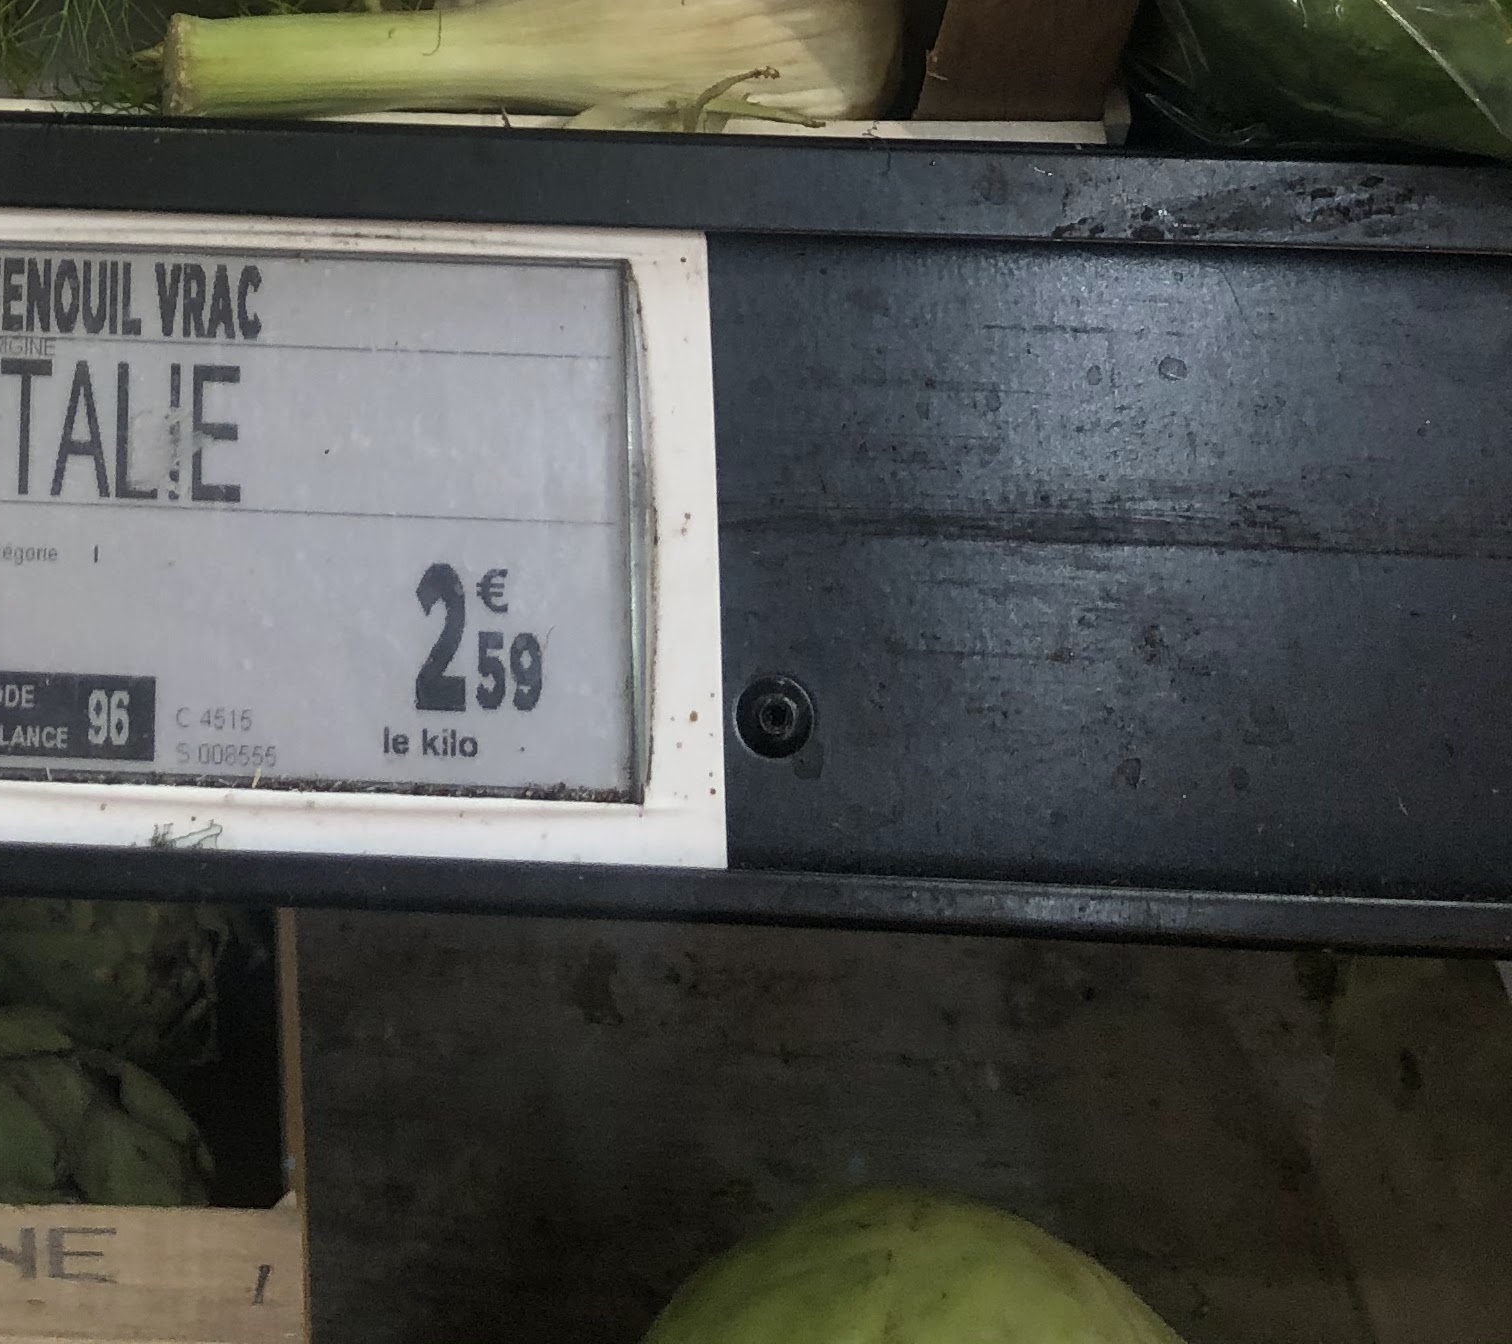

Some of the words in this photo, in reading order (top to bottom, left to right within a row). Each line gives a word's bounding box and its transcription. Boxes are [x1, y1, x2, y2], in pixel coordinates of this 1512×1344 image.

[154, 262, 263, 340] VRAC
[475, 568, 509, 614] €
[414, 562, 467, 713] 2
[474, 630, 544, 712] 59
[87, 688, 131, 747] 96
[175, 706, 192, 729] C
[383, 725, 410, 756] le
[421, 727, 479, 758] kilo
